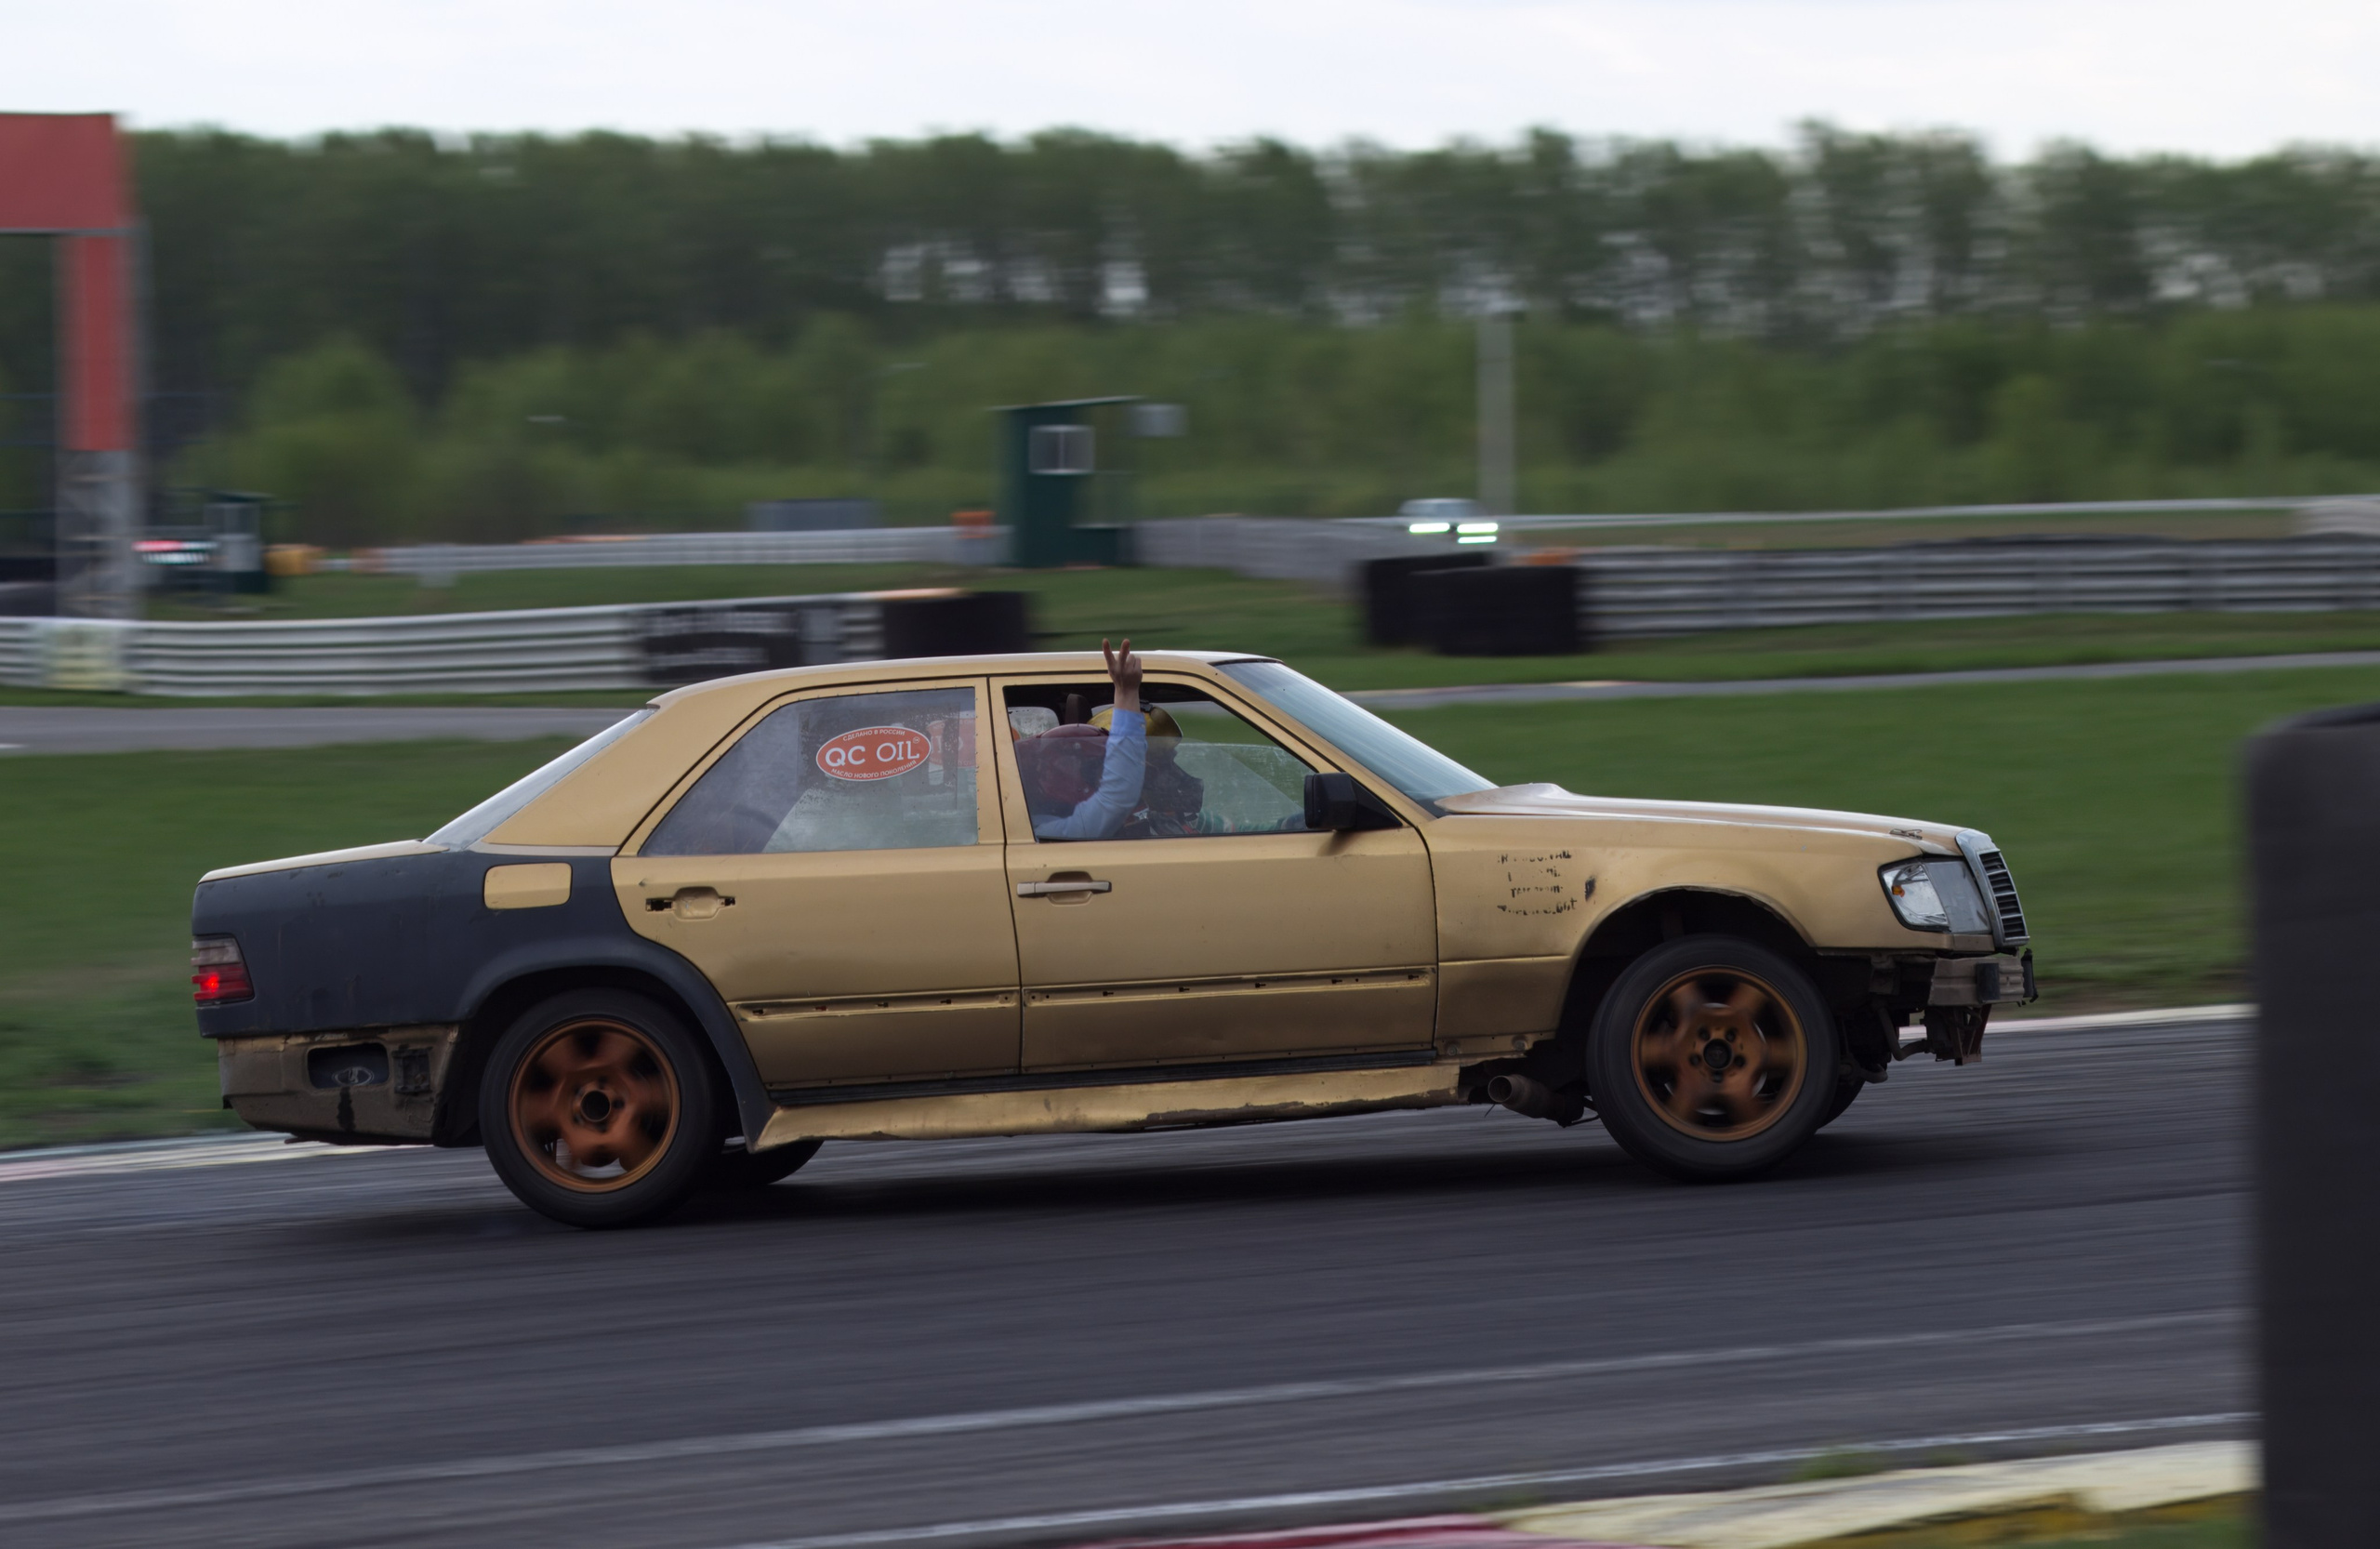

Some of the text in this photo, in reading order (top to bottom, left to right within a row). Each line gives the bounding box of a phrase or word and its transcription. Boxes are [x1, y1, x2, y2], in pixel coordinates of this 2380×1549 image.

[842, 730, 873, 741] СДЕЛАНО
[825, 745, 866, 767] QC
[876, 740, 920, 762] OIL
[831, 768, 853, 778] МАСЛО
[879, 760, 917, 776] ПОКОЛЕНИЯ
